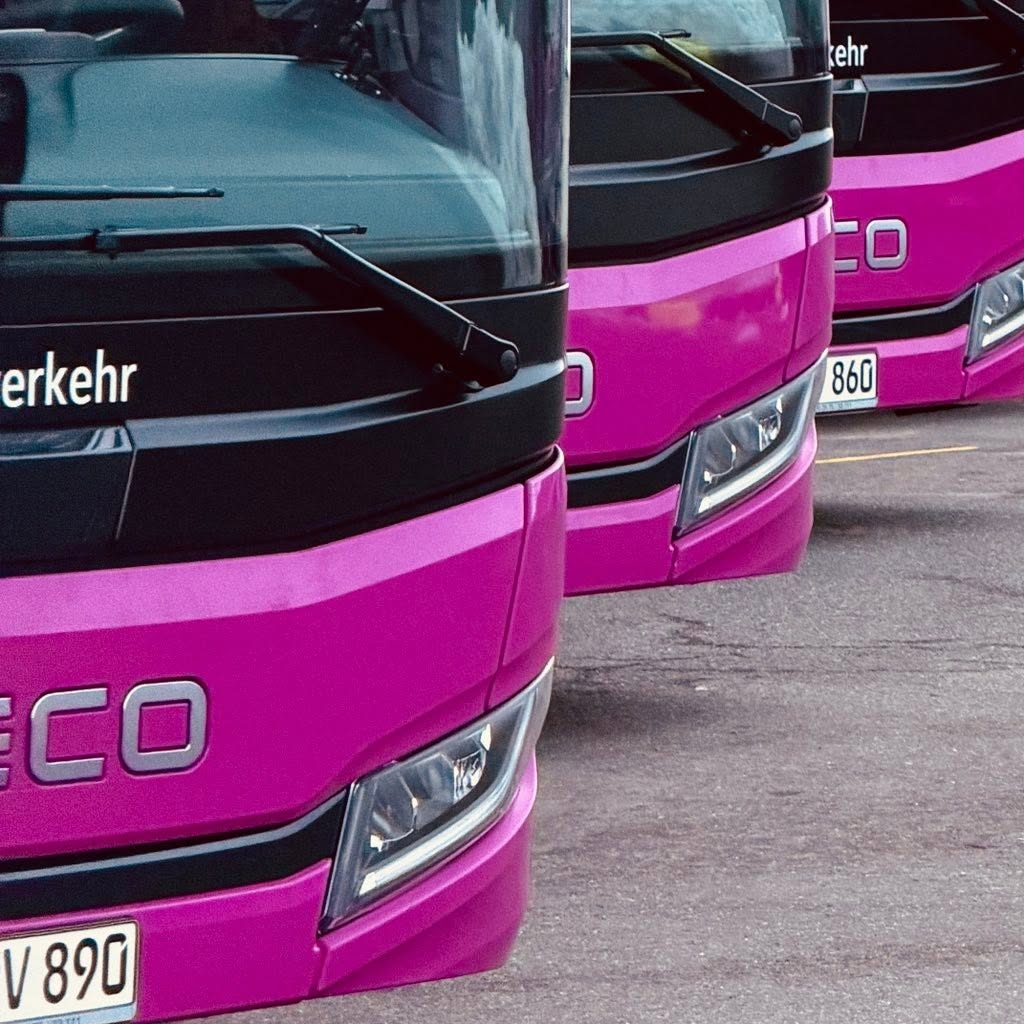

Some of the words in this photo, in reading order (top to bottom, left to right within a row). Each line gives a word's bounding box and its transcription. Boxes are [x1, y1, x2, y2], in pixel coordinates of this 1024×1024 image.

[0, 348, 138, 408] erkehr
[832, 358, 873, 396] 860
[0, 680, 208, 788] CO
[4, 945, 31, 1010] V
[43, 932, 128, 1004] 890
